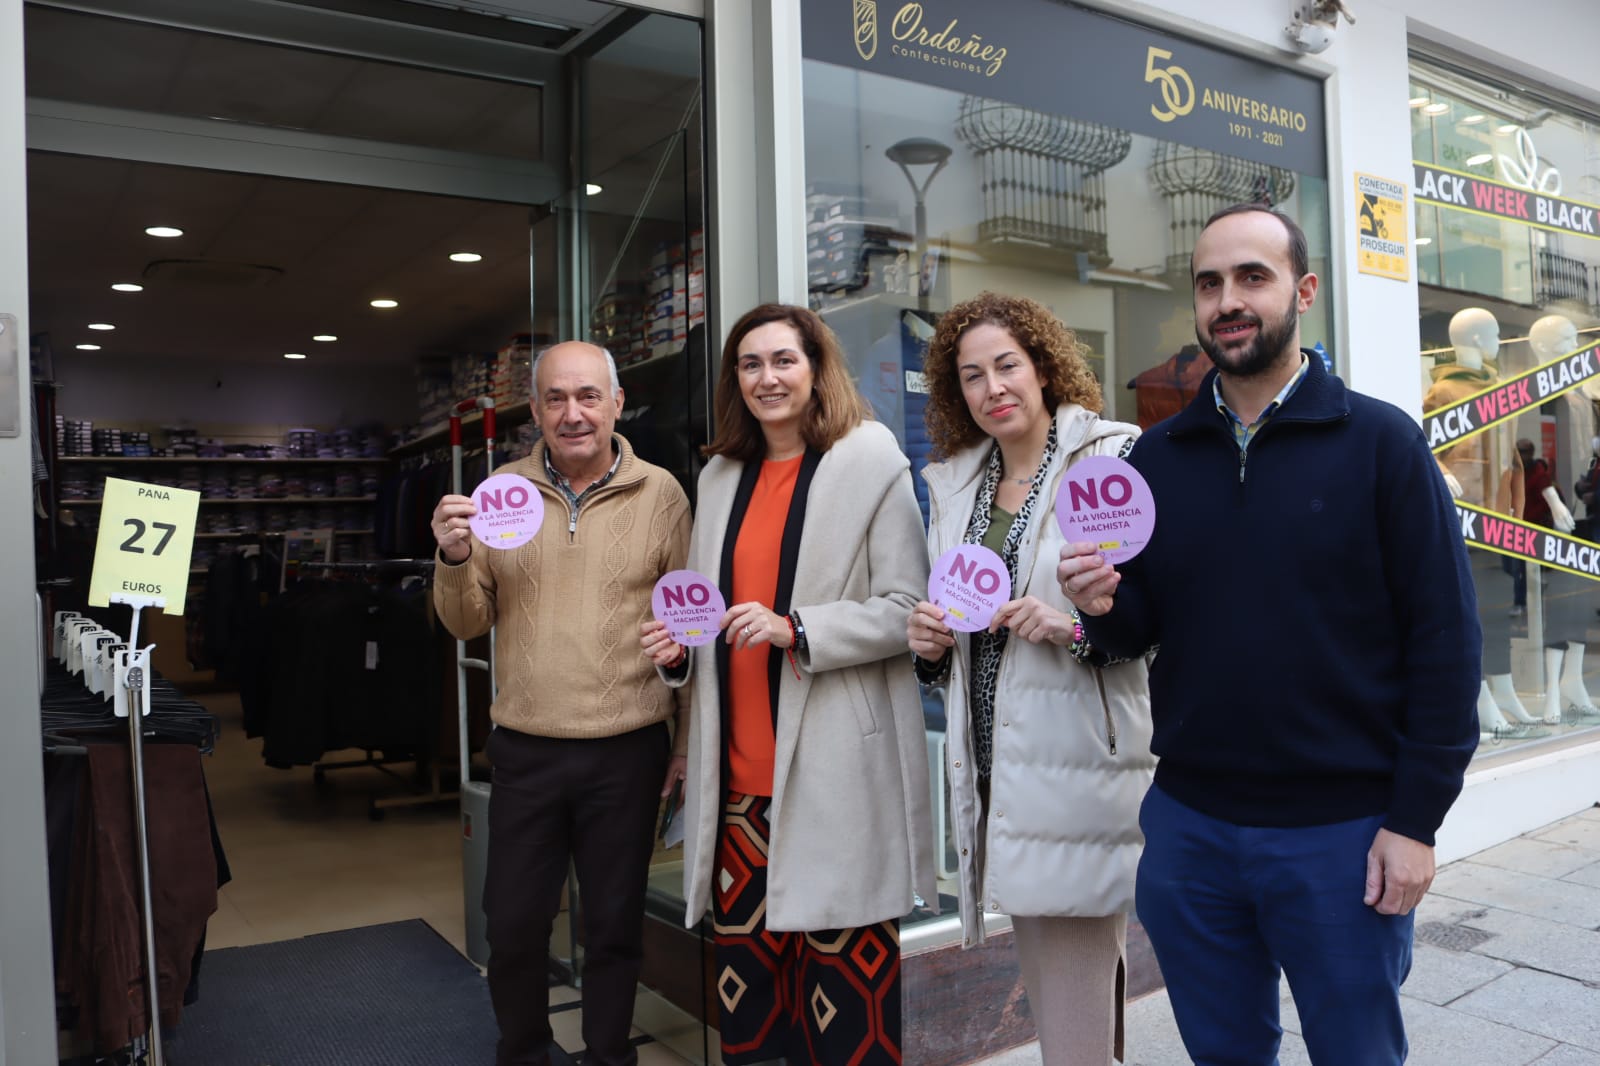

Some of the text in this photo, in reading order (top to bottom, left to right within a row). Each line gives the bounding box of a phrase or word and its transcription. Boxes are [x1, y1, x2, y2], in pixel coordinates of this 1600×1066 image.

[891, 3, 1007, 77] Ordoñez
[891, 44, 982, 74] Confecciones
[1145, 46, 1307, 132] 50 ANIVERSARIO
[1229, 122, 1252, 140] 1971
[1263, 131, 1283, 147] 2021
[1358, 176, 1403, 194] CONECTADA
[1414, 170, 1467, 205] LACK
[1471, 181, 1529, 219] WEEK
[1536, 197, 1594, 233] BLACK
[1360, 237, 1405, 256] PROSEGUR
[1429, 403, 1474, 449] ACK
[1475, 378, 1533, 424] WEEK
[1536, 351, 1594, 398] BLACK
[138, 488, 170, 500] PANA
[480, 486, 529, 513] NO
[1068, 474, 1133, 512] NO
[488, 518, 526, 528] MACHISTA
[496, 509, 535, 519] VIOLENCIA
[1069, 507, 1142, 523] A LA VIOLENCIA
[119, 518, 177, 556] 27
[1082, 521, 1131, 533] MACHISTA
[1482, 515, 1538, 557] WEEK
[1544, 535, 1600, 575] BLACK
[948, 552, 1001, 595] NO
[122, 581, 162, 594] EUROS
[661, 583, 710, 608] NO
[945, 588, 981, 612] MACHISTA
[946, 580, 956, 588] LA
[957, 584, 994, 609] VIOLENCIA
[673, 615, 709, 624] MACHISTA
[680, 607, 717, 616] VIOLENCIA
